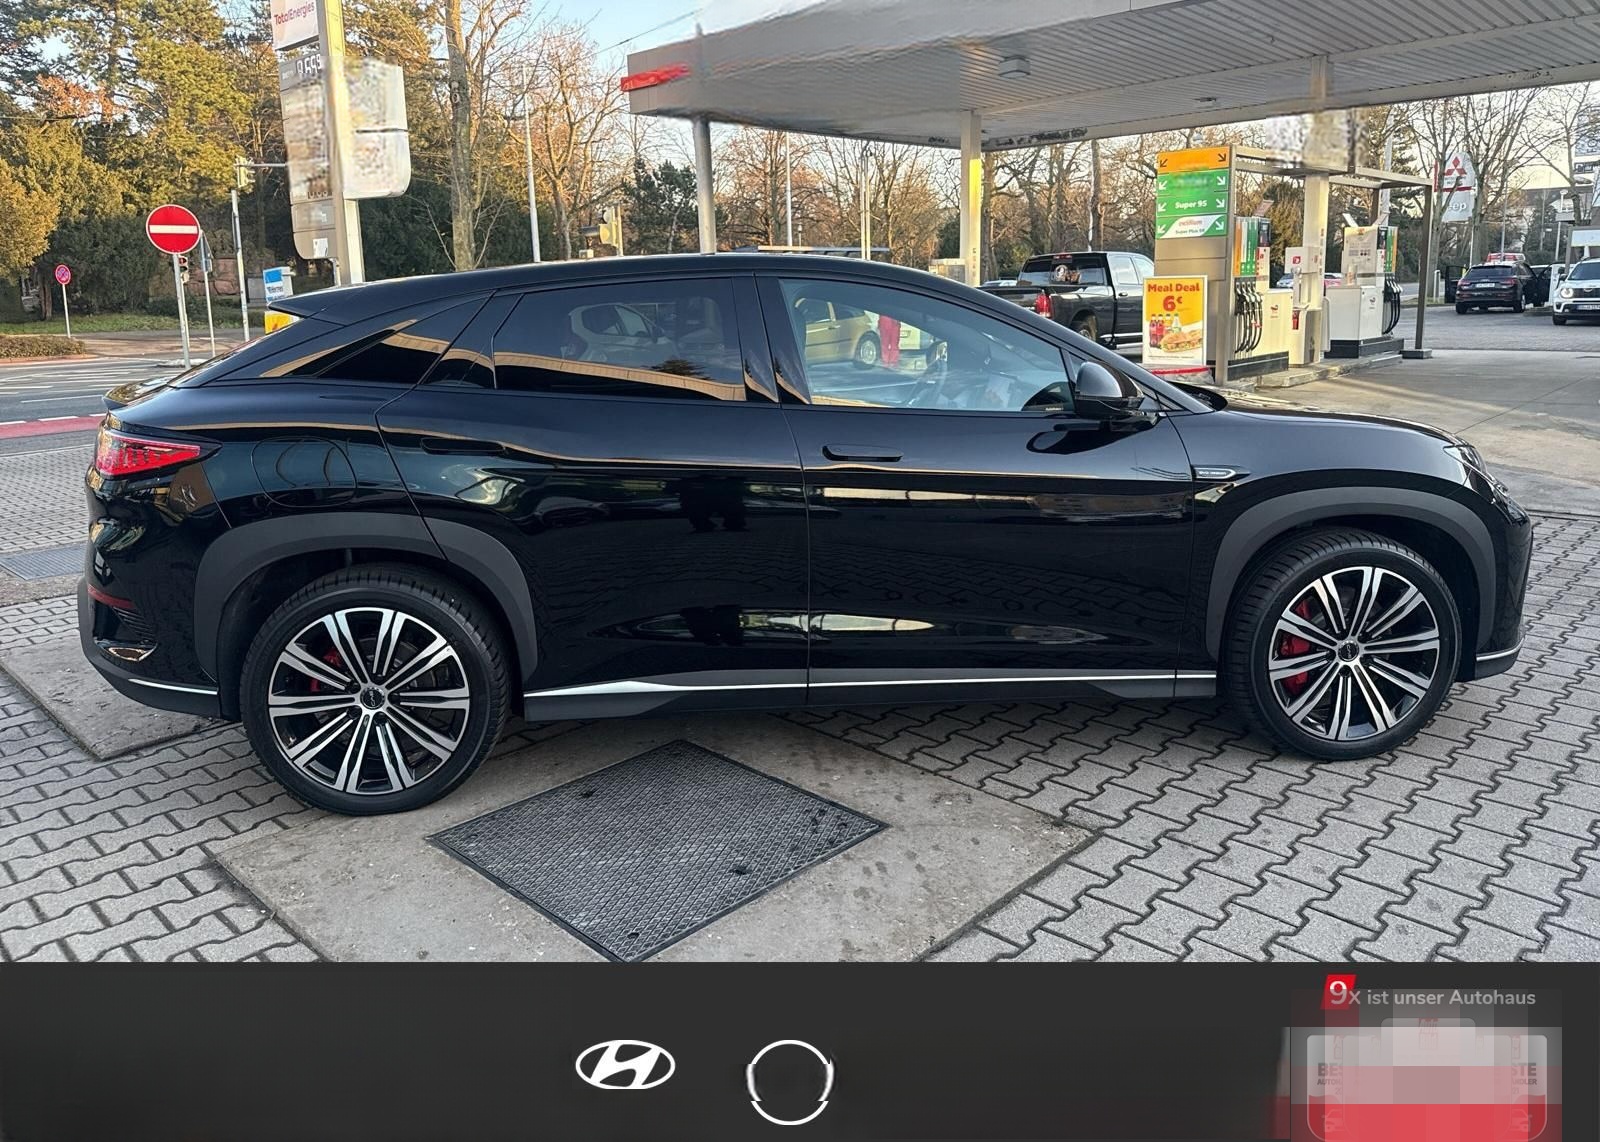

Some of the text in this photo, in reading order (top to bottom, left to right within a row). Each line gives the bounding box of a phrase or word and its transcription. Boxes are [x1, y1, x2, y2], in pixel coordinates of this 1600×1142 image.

[274, 2, 314, 25] TotalEnergies
[1175, 200, 1208, 210] Super 95
[1147, 282, 1201, 293] Meal Deal
